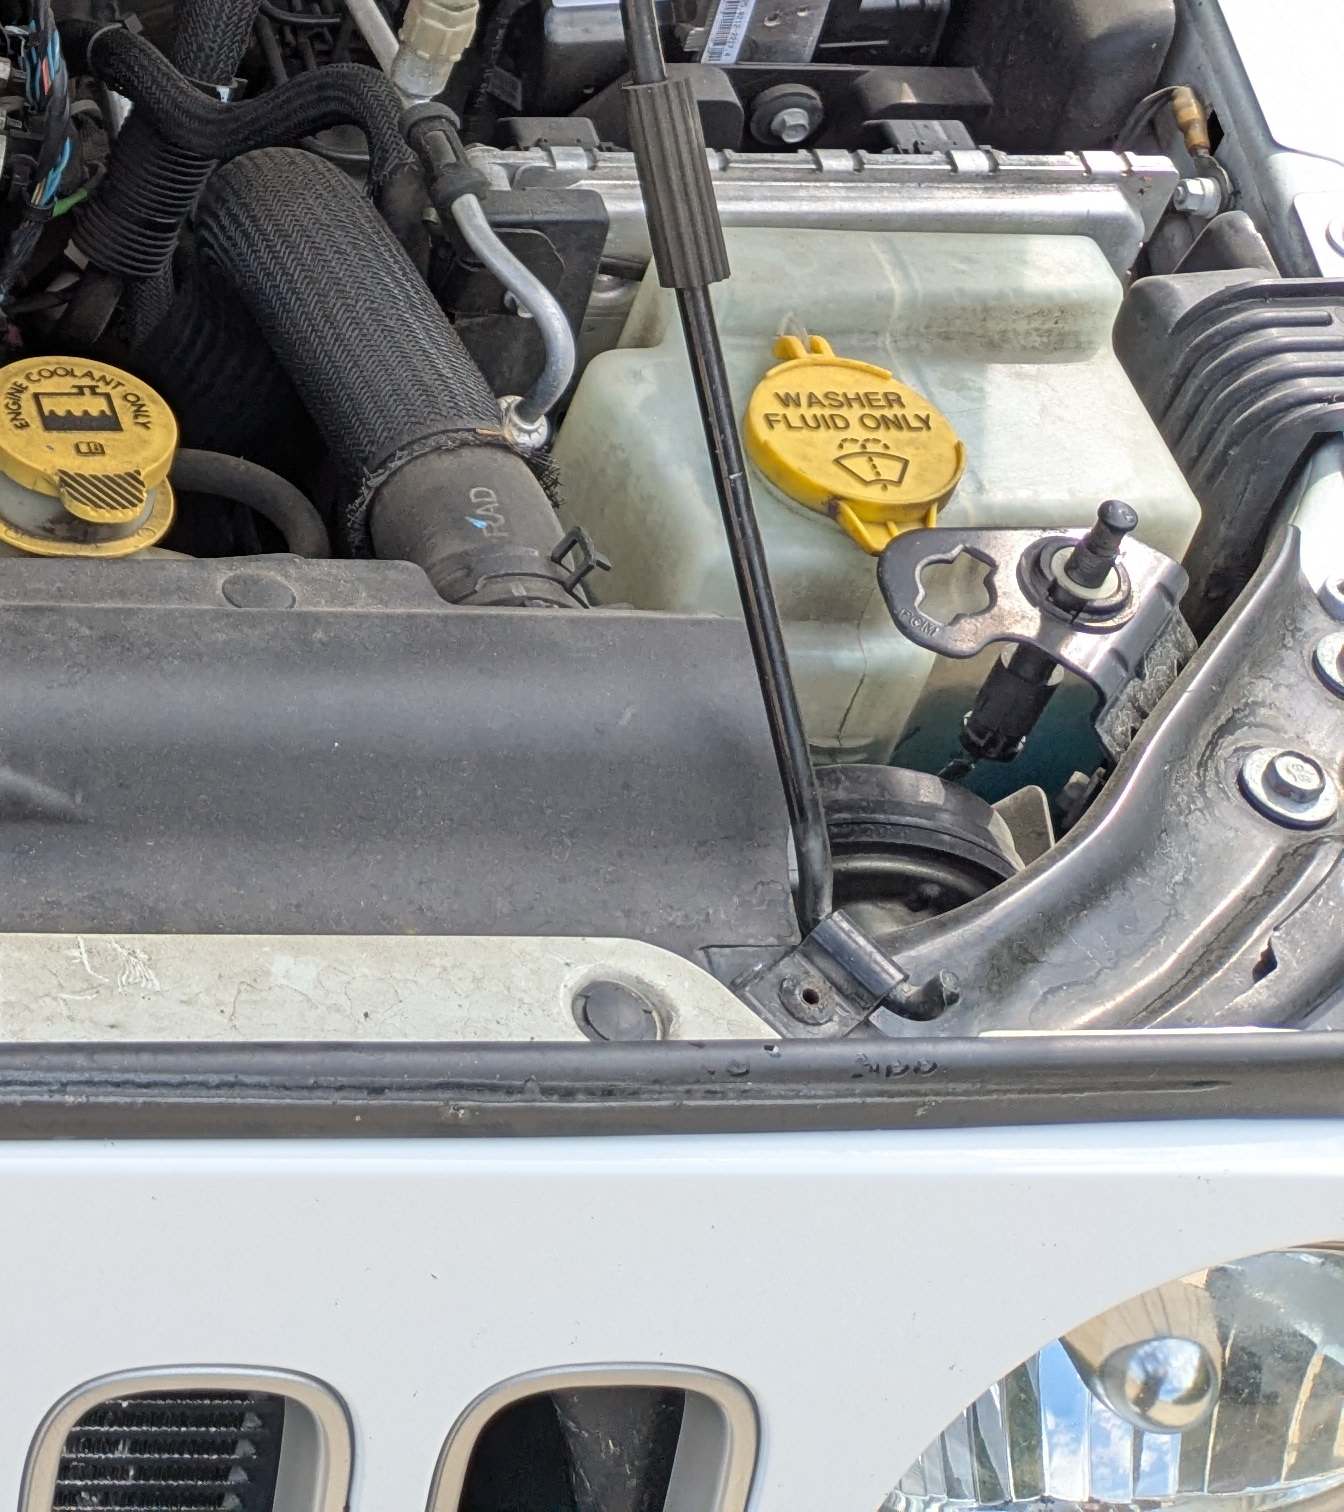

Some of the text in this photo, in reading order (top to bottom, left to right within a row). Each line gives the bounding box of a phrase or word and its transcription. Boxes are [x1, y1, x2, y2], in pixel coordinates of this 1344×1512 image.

[3, 366, 154, 432] ENGINE COOLANT ONLY
[772, 390, 907, 410] WASHER
[763, 412, 933, 432] FLUID ONLY
